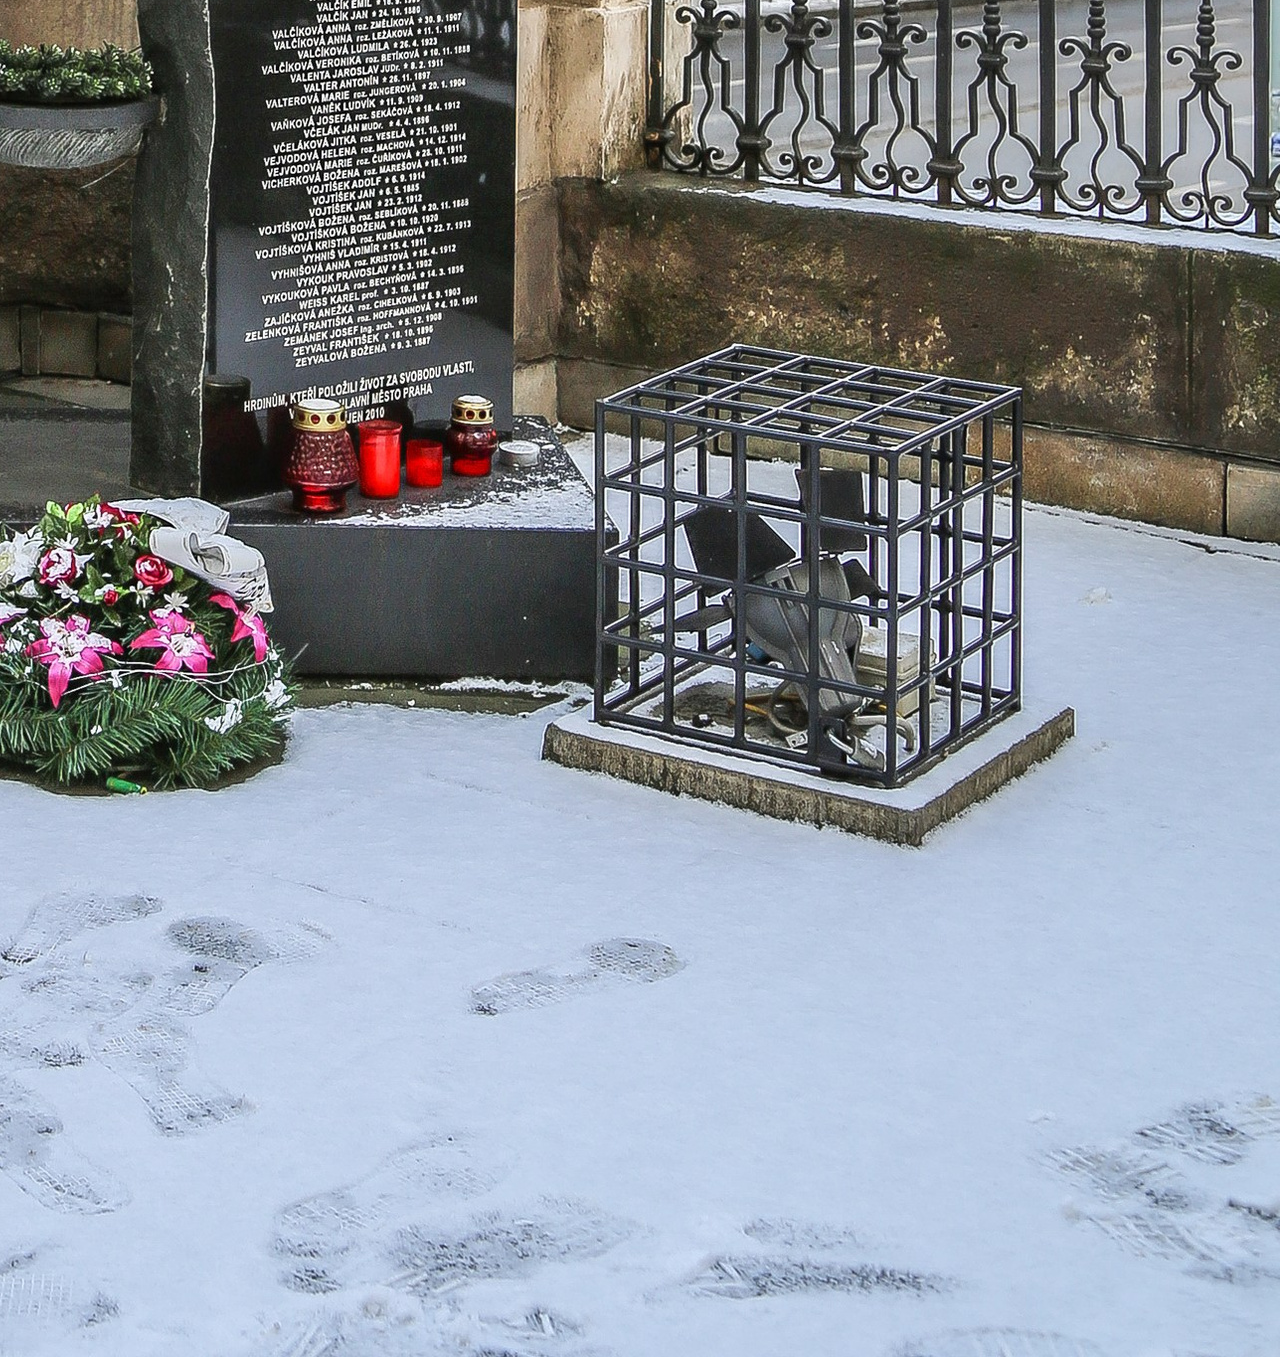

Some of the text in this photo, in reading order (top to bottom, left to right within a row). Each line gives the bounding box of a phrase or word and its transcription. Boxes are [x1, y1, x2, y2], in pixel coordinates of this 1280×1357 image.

[243, 392, 288, 414] HRDINŮM,
[318, 379, 358, 398] POLOŽILI
[359, 375, 385, 391] ŽIVOT
[385, 373, 398, 387] ZA
[399, 365, 441, 384] SVOBODU
[442, 360, 474, 376] VLASTI,
[371, 388, 401, 404] MĚSTO
[403, 382, 433, 399] PRAHA
